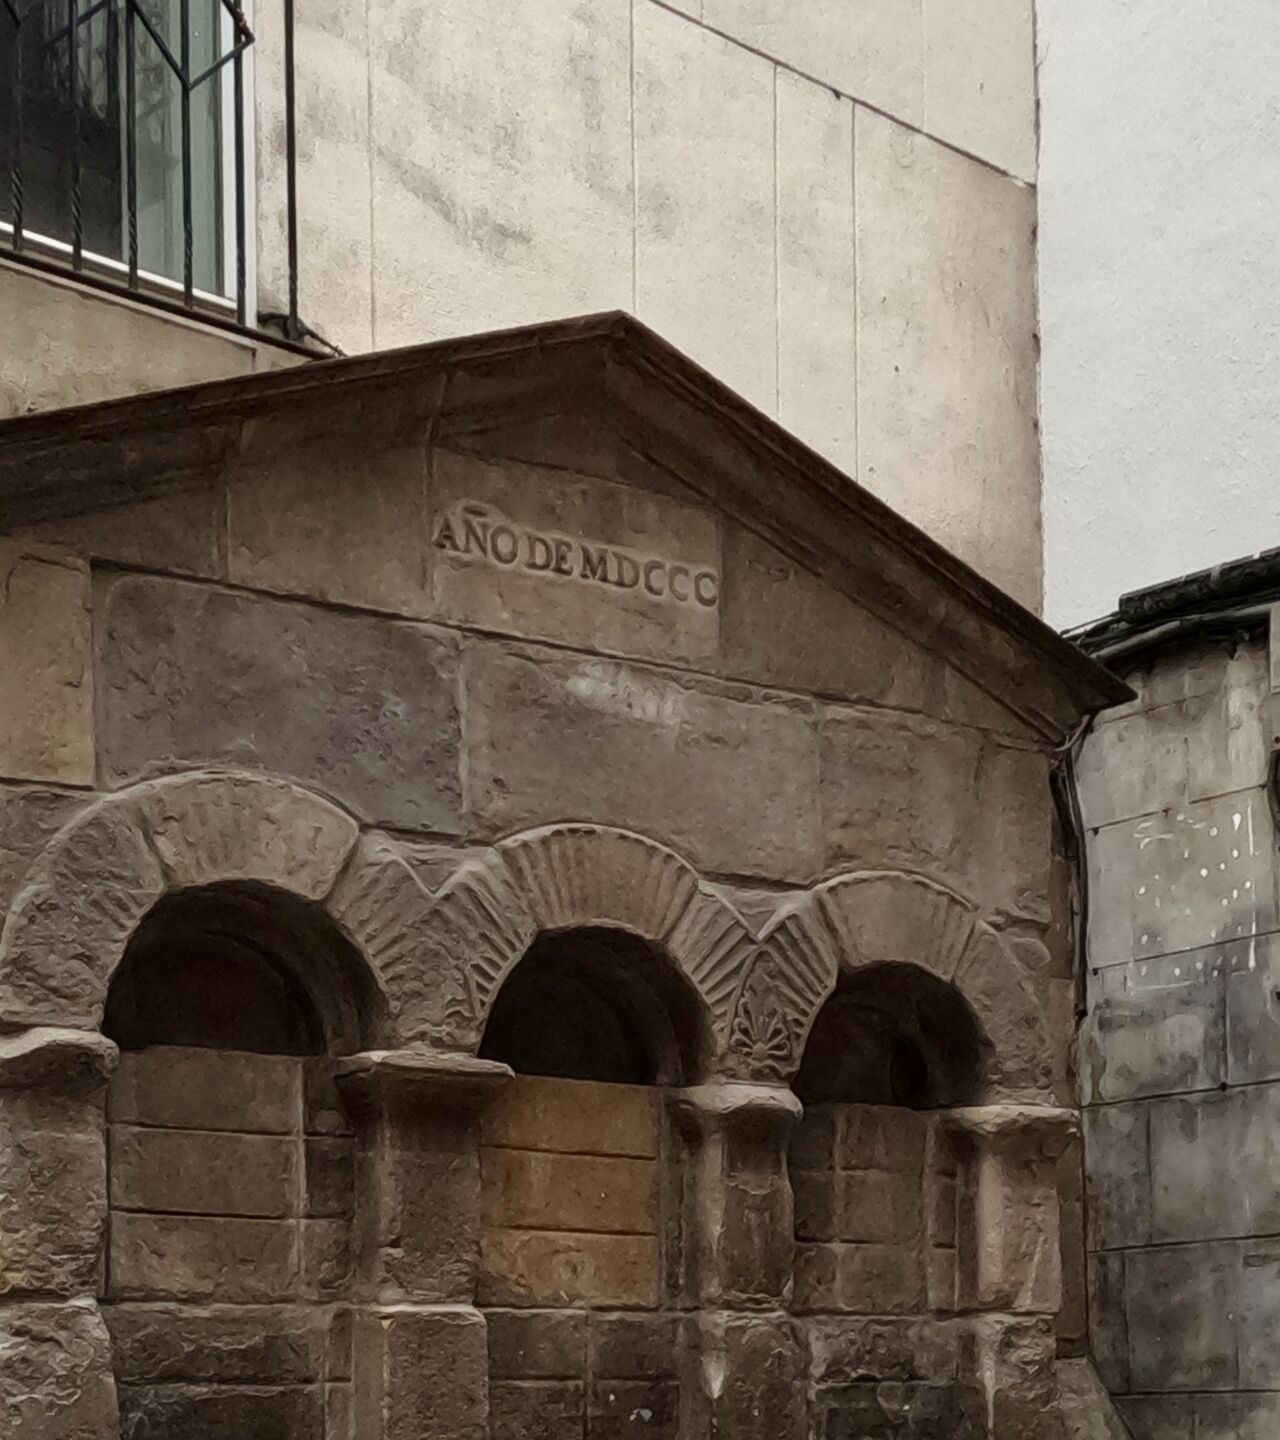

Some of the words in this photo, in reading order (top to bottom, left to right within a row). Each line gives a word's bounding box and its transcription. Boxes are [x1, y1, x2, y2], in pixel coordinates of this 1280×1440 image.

[432, 504, 519, 566] AÑO
[524, 533, 575, 577] DE
[579, 545, 720, 608] MDCCC
